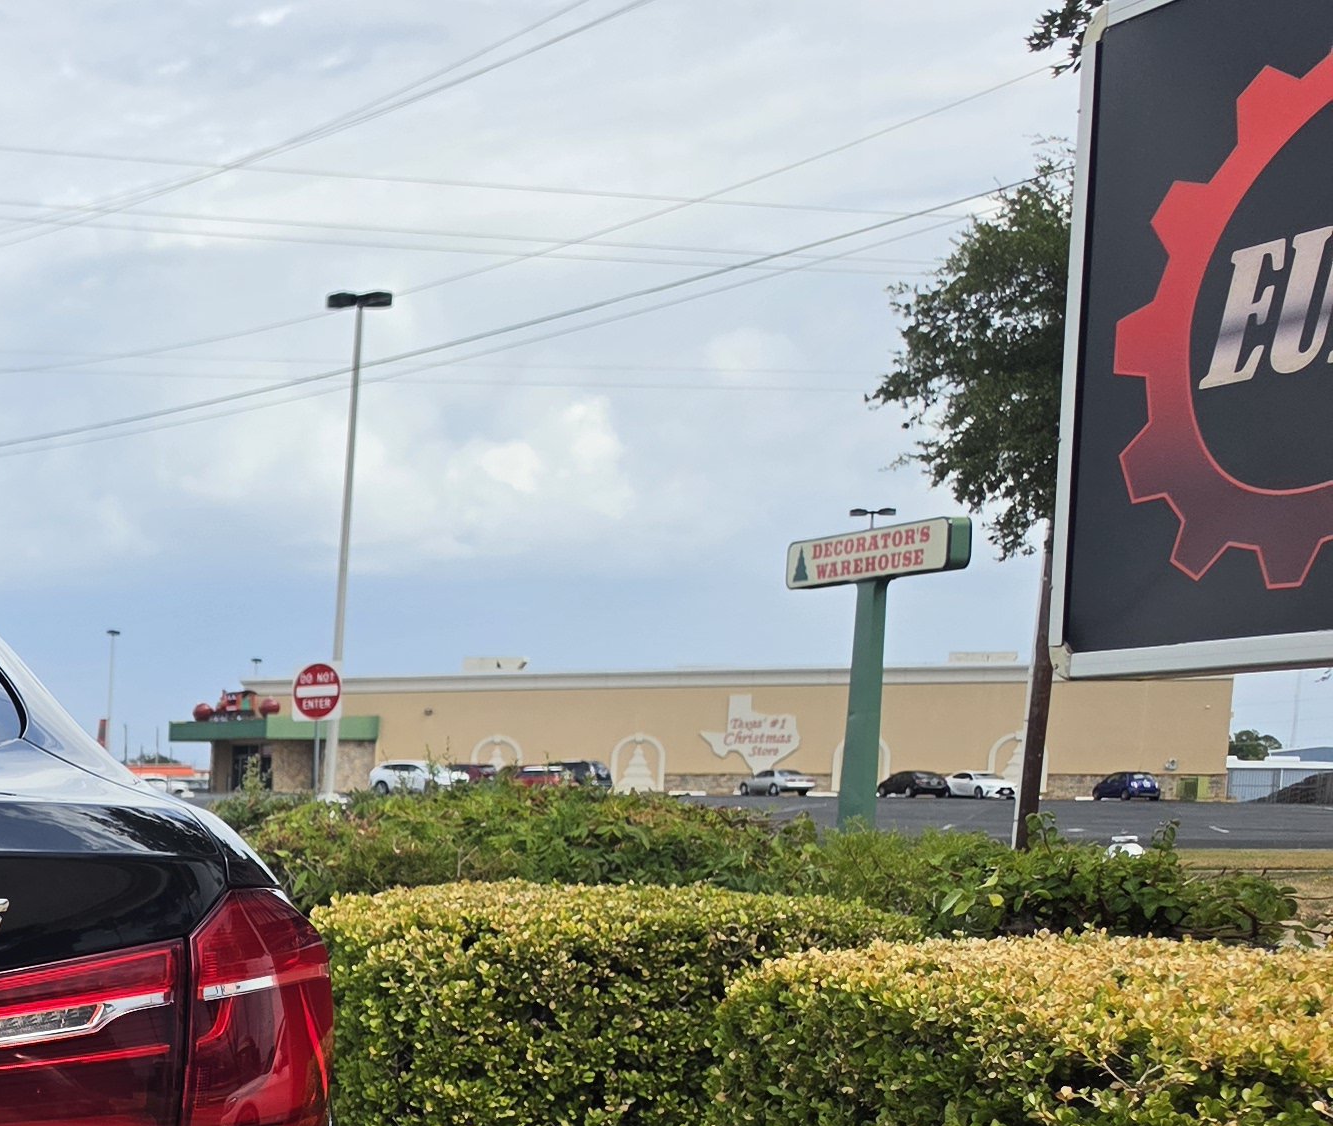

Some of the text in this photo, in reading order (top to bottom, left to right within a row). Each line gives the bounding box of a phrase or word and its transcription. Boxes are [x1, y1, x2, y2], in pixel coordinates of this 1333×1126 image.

[1199, 225, 1333, 390] EU
[812, 526, 931, 559] DECORATOR'S
[816, 549, 924, 579] WAREHOUSE
[300, 671, 335, 684] DO NOT
[302, 697, 332, 710] ENTER
[724, 730, 792, 746] Christmas
[748, 746, 779, 757] Store
